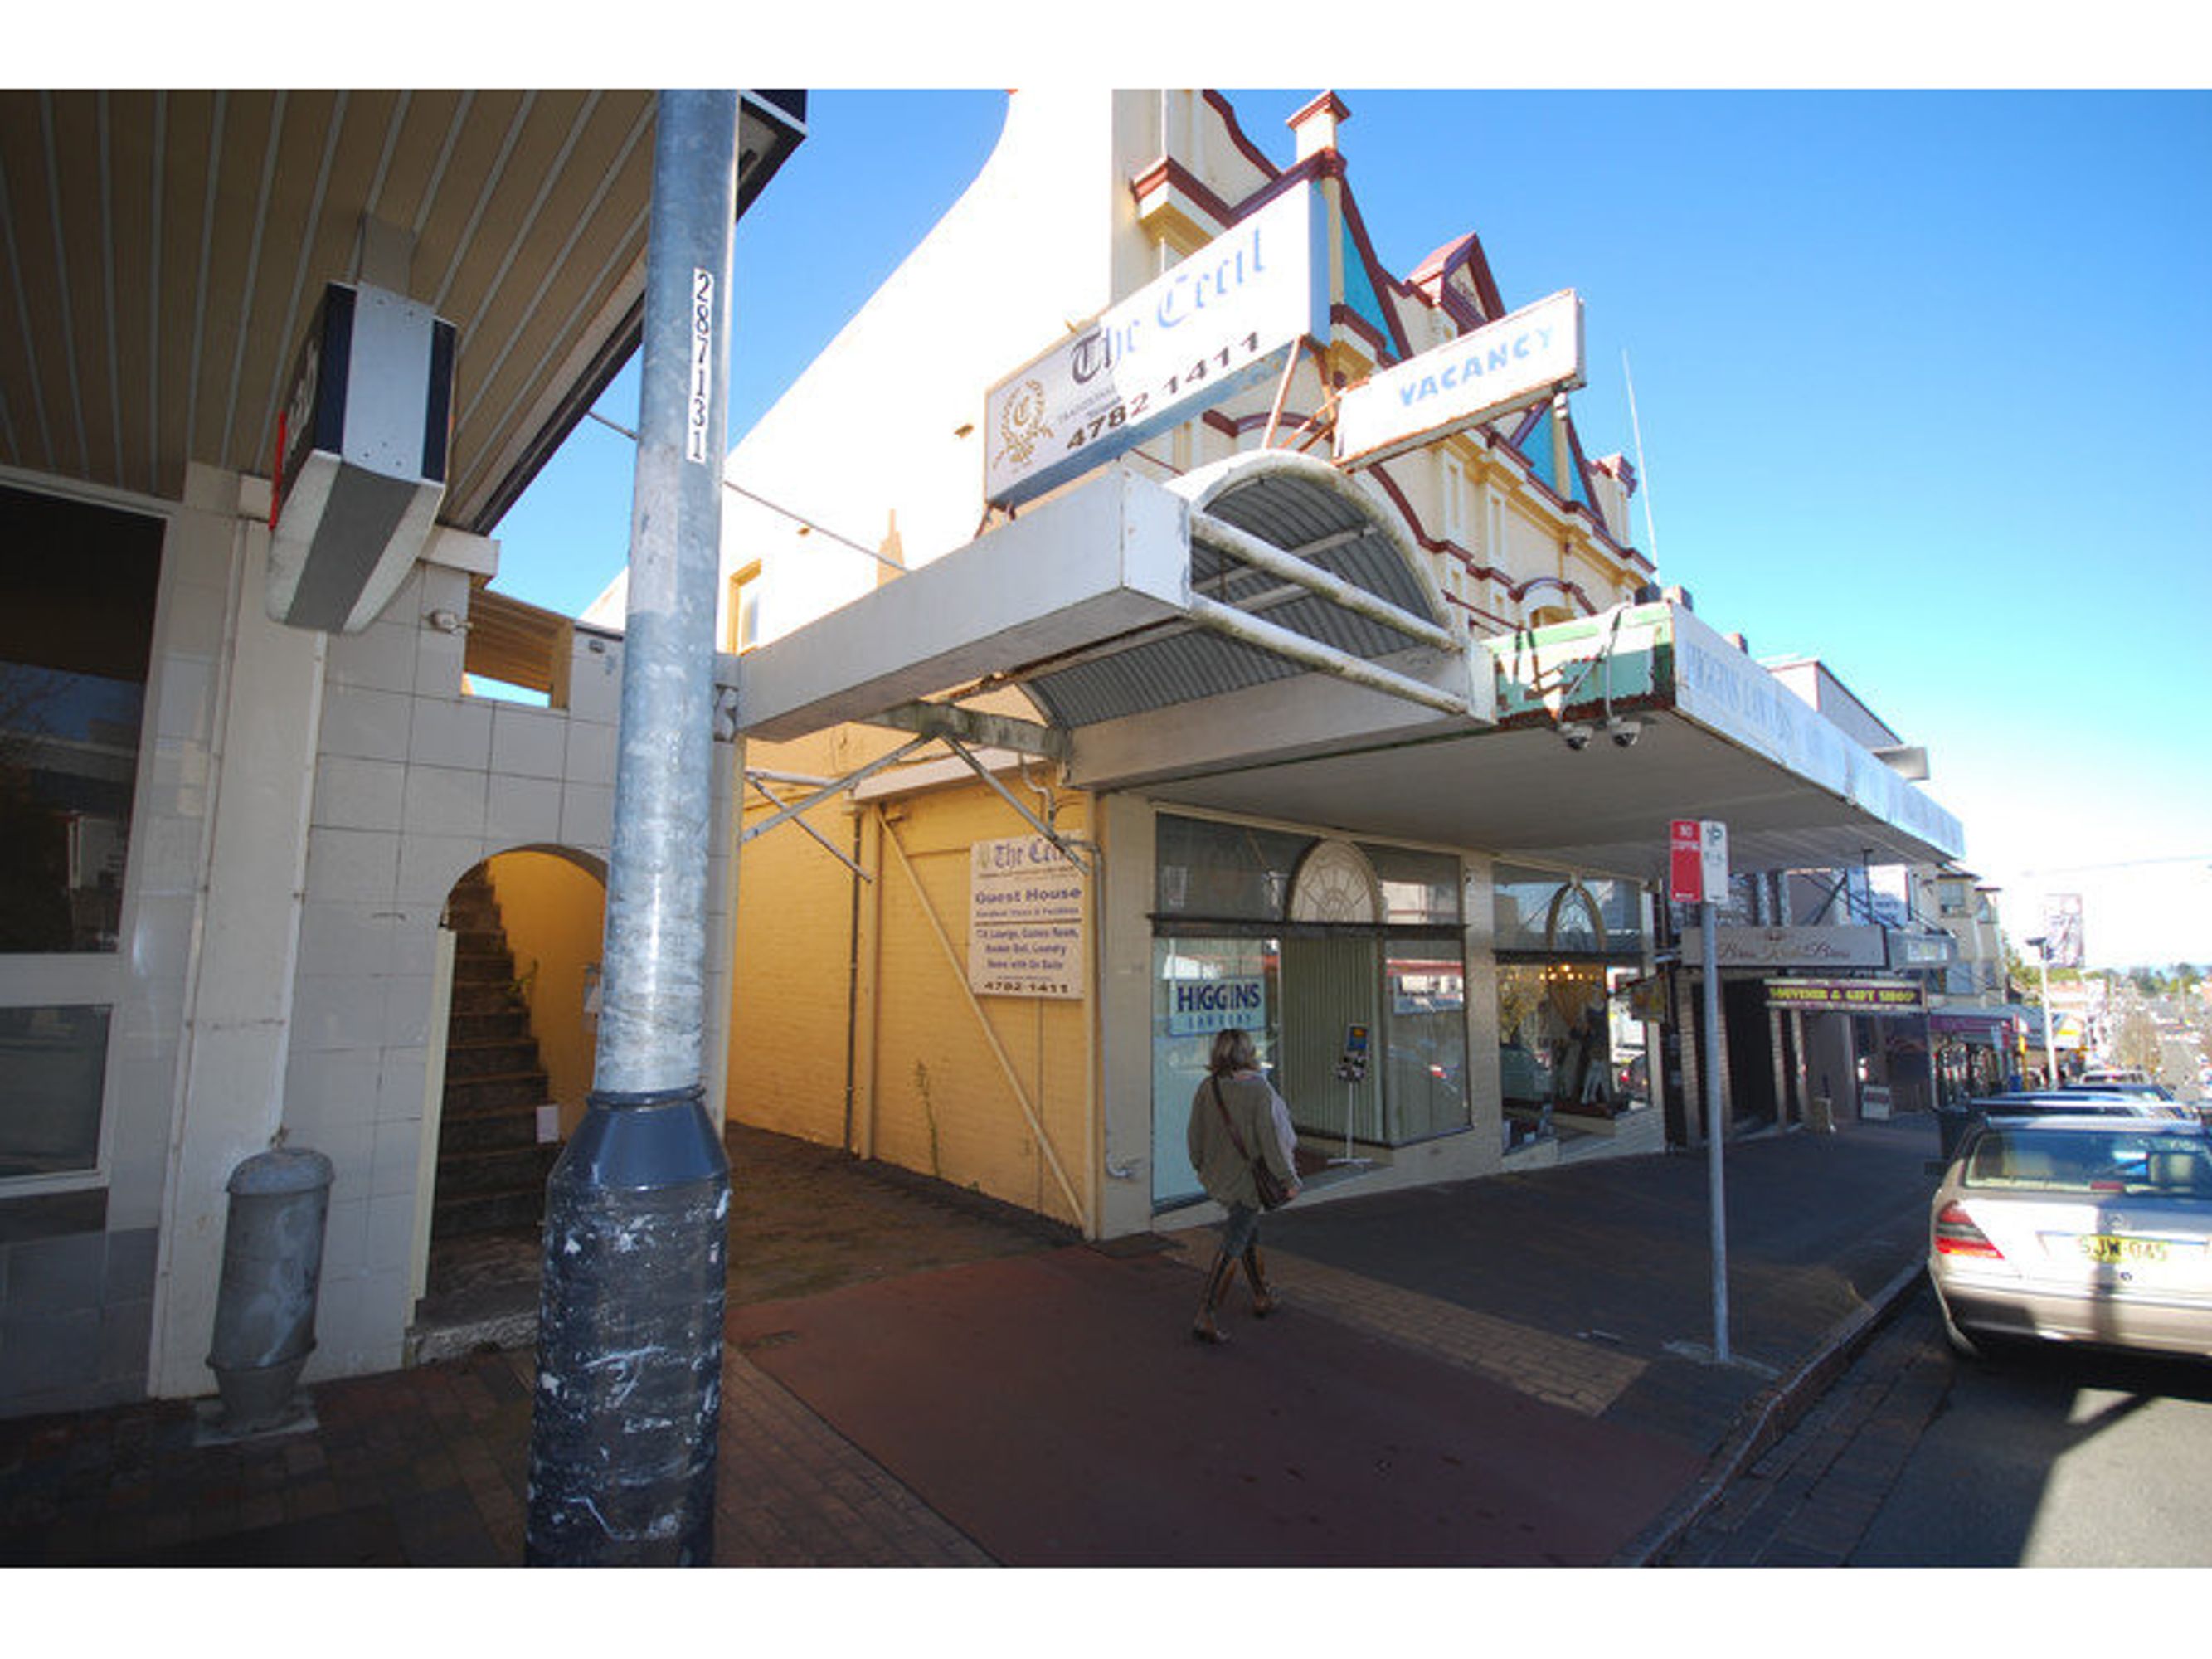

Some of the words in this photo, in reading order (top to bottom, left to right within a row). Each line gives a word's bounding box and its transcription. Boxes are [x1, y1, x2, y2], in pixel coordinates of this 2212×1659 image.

[1070, 319, 1140, 385] The
[1156, 227, 1266, 328] Cecil
[693, 274, 710, 460] 287131
[1067, 392, 1149, 449] 4782
[1162, 331, 1258, 394] 1411
[1399, 324, 1553, 406] VACANCY
[975, 889, 1022, 904] Guest
[1025, 887, 1082, 902] House
[994, 843, 1023, 868] The
[1178, 983, 1262, 1012] HIGGINS
